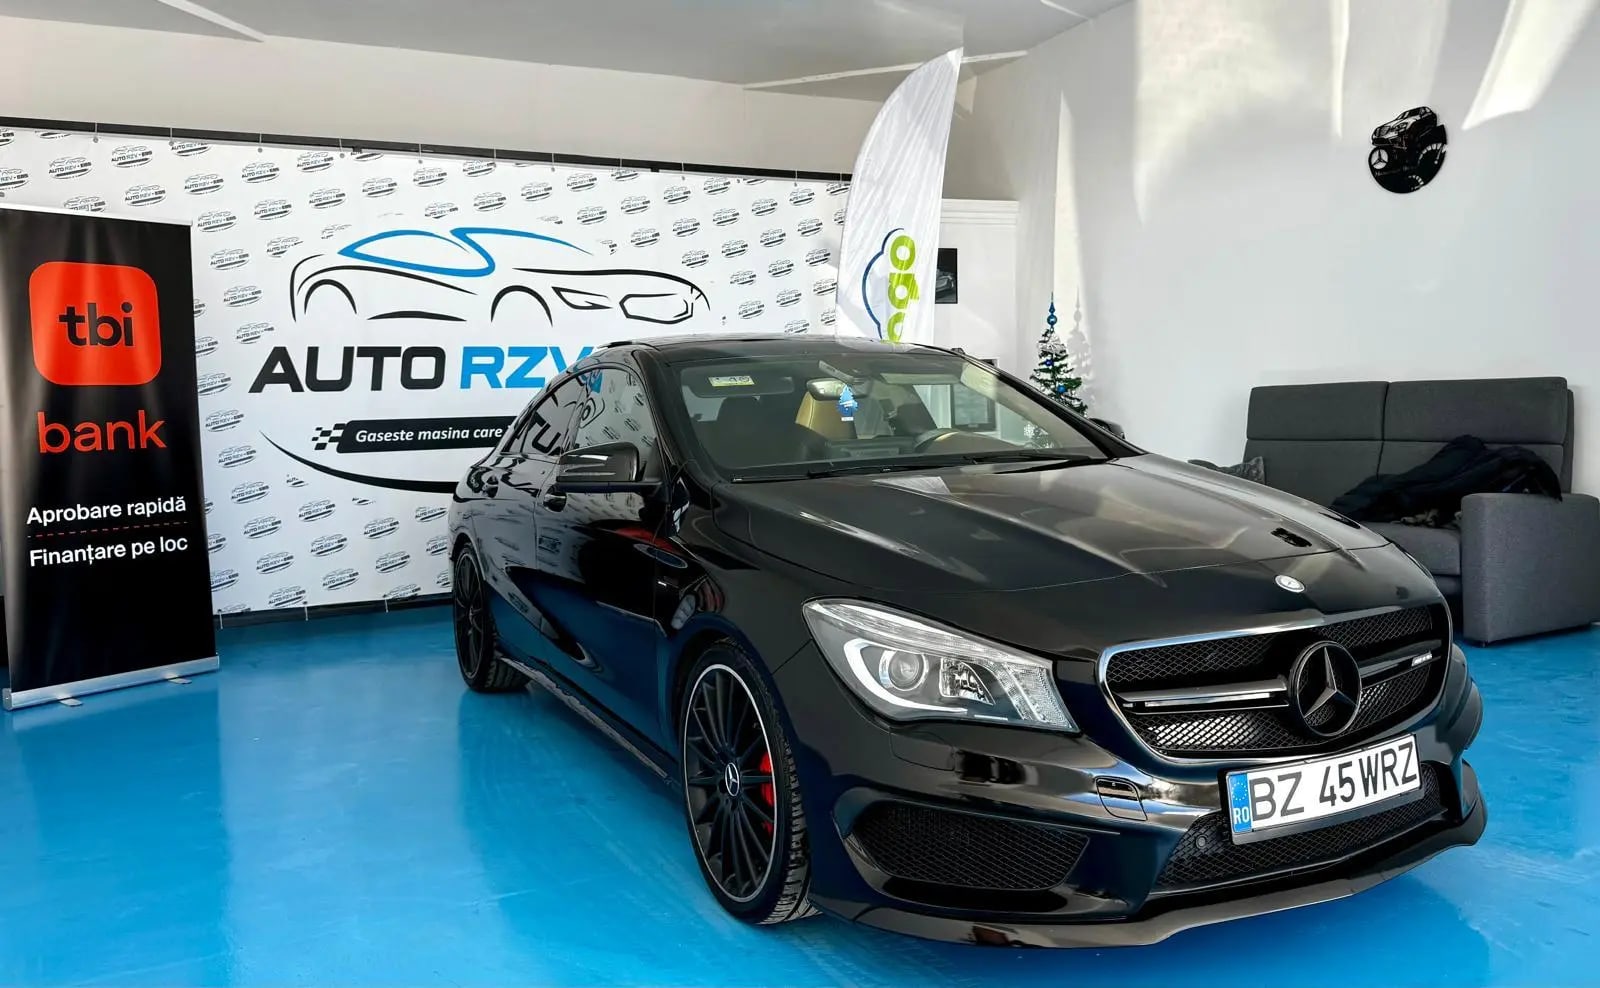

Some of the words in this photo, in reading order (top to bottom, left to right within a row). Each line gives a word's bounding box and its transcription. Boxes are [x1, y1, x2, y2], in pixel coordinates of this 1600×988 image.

[59, 302, 134, 346] tbi
[248, 346, 446, 393] AUTO
[37, 410, 167, 453] bank
[356, 430, 414, 442] Gaseste
[418, 427, 469, 440] masina
[473, 428, 502, 438] care
[26, 504, 122, 526] Aprobare
[127, 496, 186, 517] rapidă
[30, 544, 126, 567] Finanțare
[132, 540, 155, 559] pe
[160, 536, 188, 552] loc
[1250, 772, 1304, 821] BZ
[1234, 807, 1249, 824] RO
